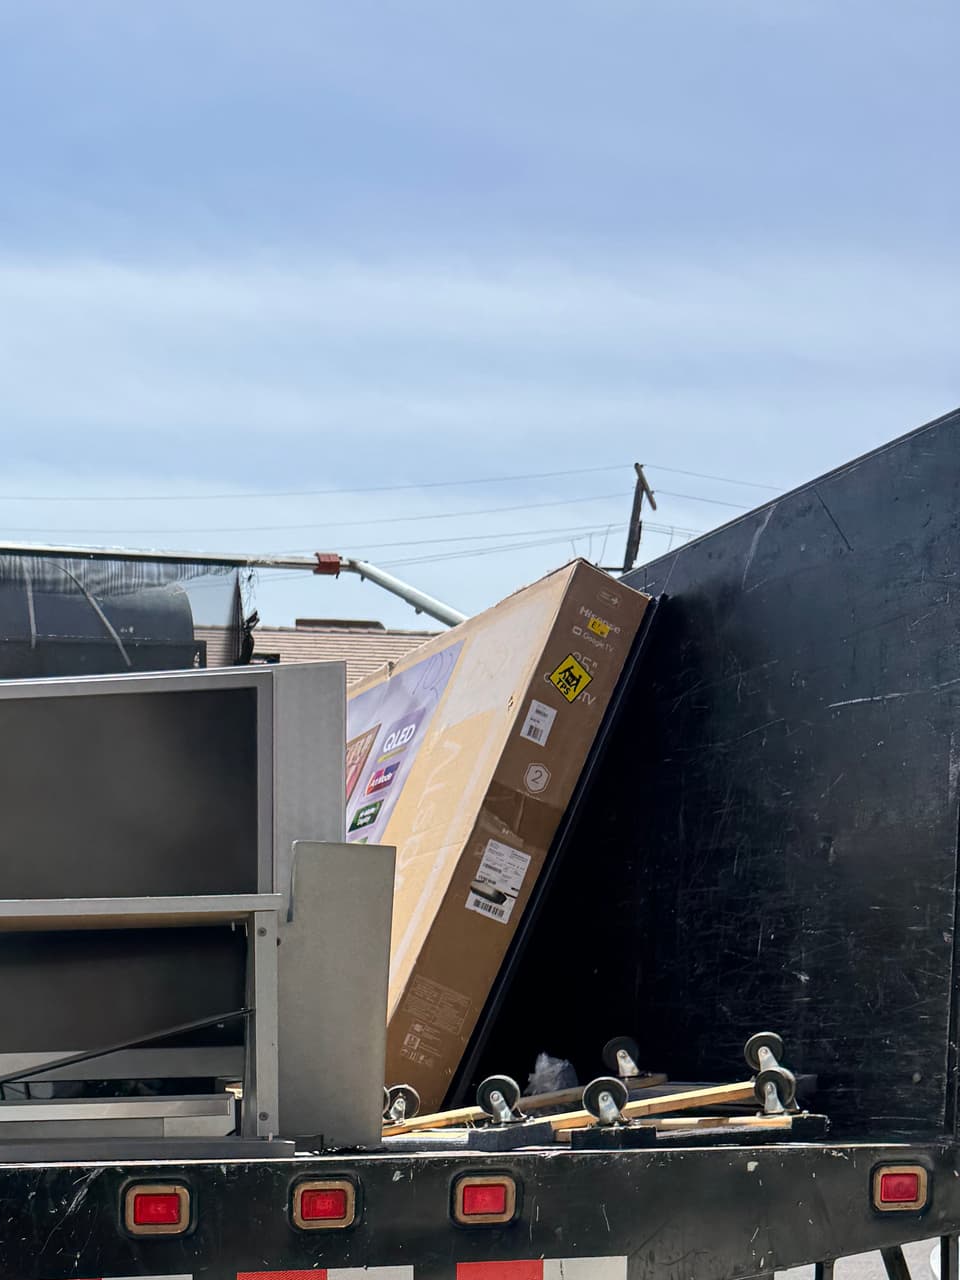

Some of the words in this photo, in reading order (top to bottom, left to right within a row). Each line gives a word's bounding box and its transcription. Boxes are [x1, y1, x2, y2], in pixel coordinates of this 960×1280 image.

[556, 677, 572, 696] TPS
[383, 723, 417, 753] QLED
[531, 769, 543, 785] 2
